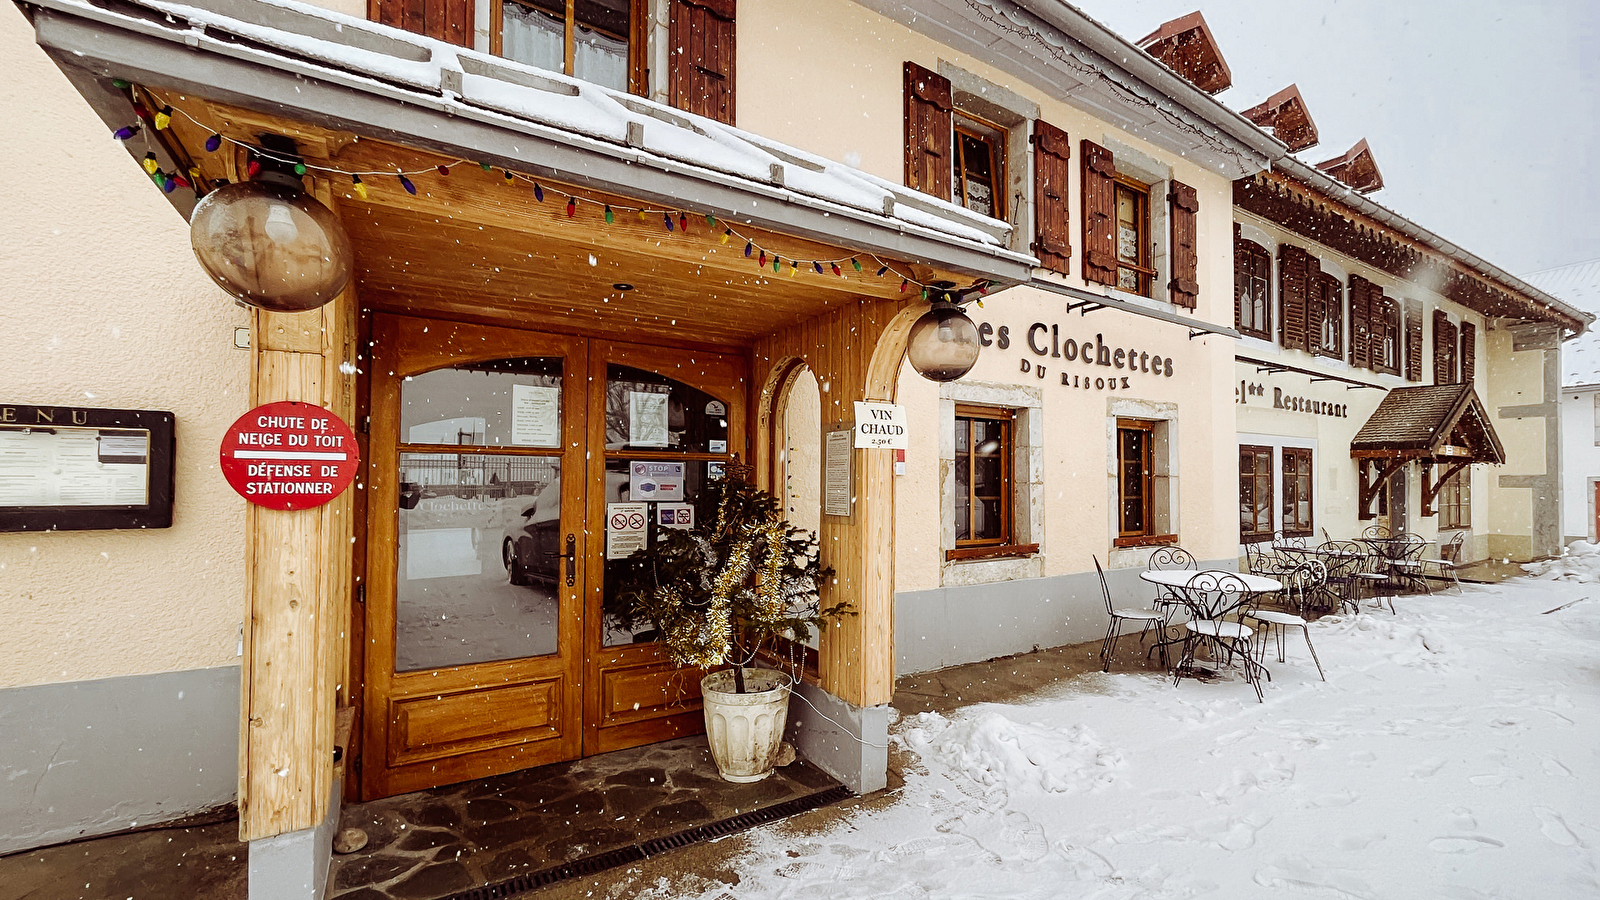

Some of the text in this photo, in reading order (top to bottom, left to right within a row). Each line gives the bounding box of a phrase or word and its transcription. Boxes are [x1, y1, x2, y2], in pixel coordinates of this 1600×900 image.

[1027, 322, 1174, 377] Clochettes
[1020, 358, 1130, 390] DU RISOUX
[1273, 386, 1348, 418] Restaurant
[0, 407, 87, 425] ENU
[870, 409, 892, 420] VIN
[257, 416, 329, 430] CHUTE DE
[861, 423, 903, 435] CHAUD
[238, 433, 344, 447] NEIGE DU TOIT
[247, 462, 339, 477] DÉFENSE DE
[246, 482, 333, 495] STATIONNER
[420, 501, 491, 511] Clochette
